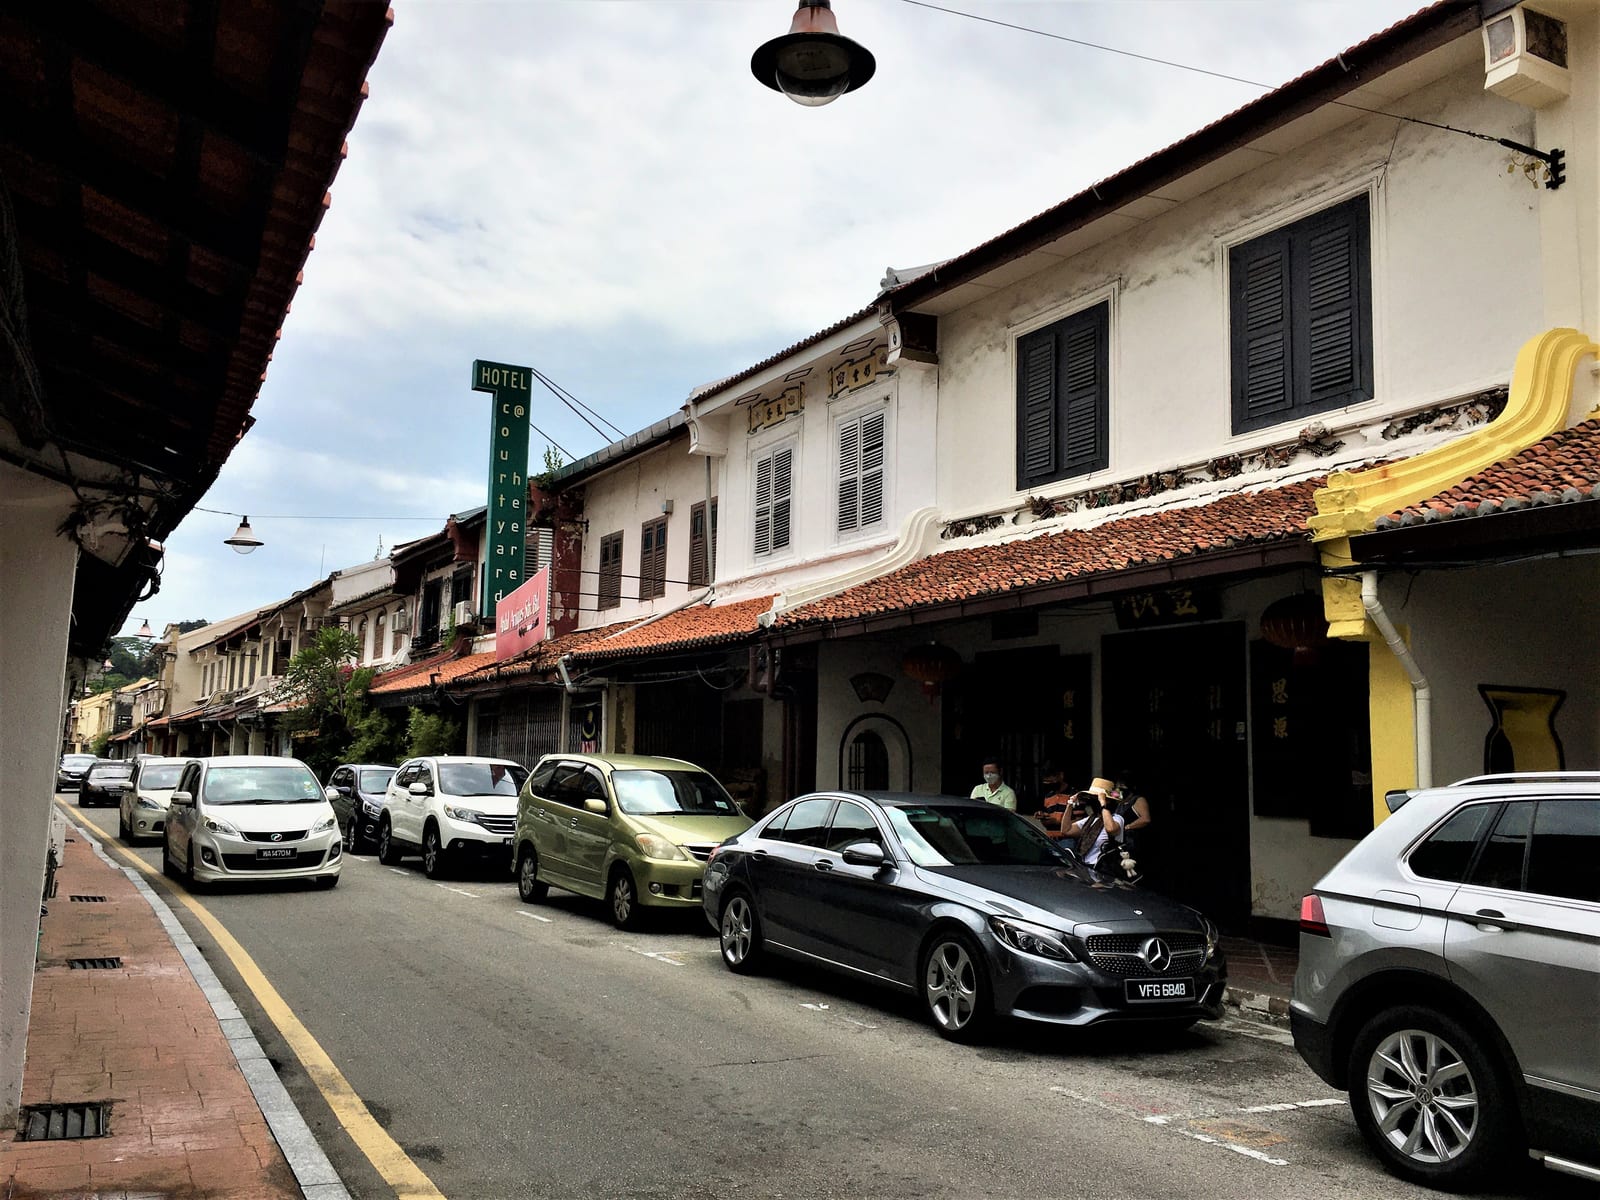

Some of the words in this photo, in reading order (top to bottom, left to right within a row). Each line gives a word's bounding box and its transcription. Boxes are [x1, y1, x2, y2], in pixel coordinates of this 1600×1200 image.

[481, 367, 528, 391] HOTEL
[513, 405, 525, 418] @
[494, 402, 511, 603] courtyard
[509, 471, 522, 580] heere
[1138, 984, 1161, 998] VFG
[1162, 983, 1186, 997] 6848
